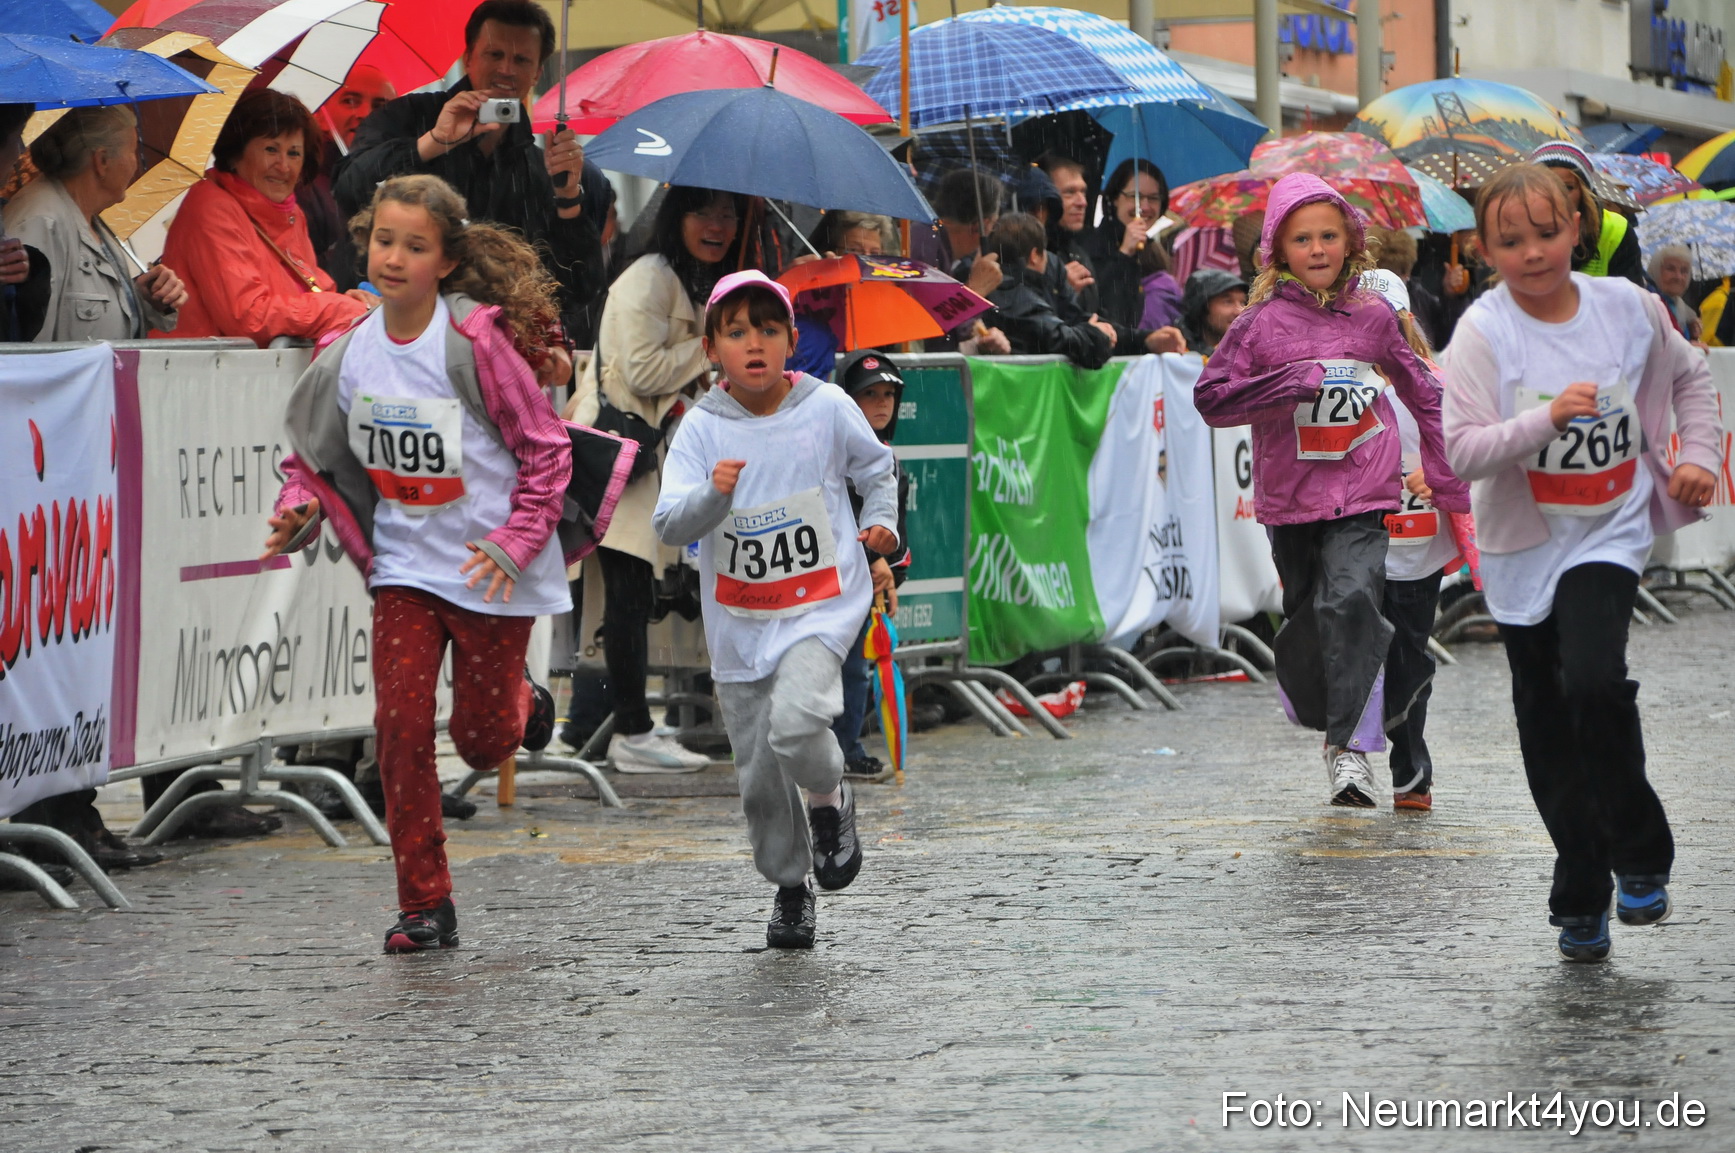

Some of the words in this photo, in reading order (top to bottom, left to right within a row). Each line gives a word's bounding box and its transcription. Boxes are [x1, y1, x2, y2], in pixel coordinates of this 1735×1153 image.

[1325, 366, 1358, 378] BOC
[359, 424, 446, 473] 7099
[734, 506, 787, 529] BOCK
[724, 524, 820, 580] 7349
